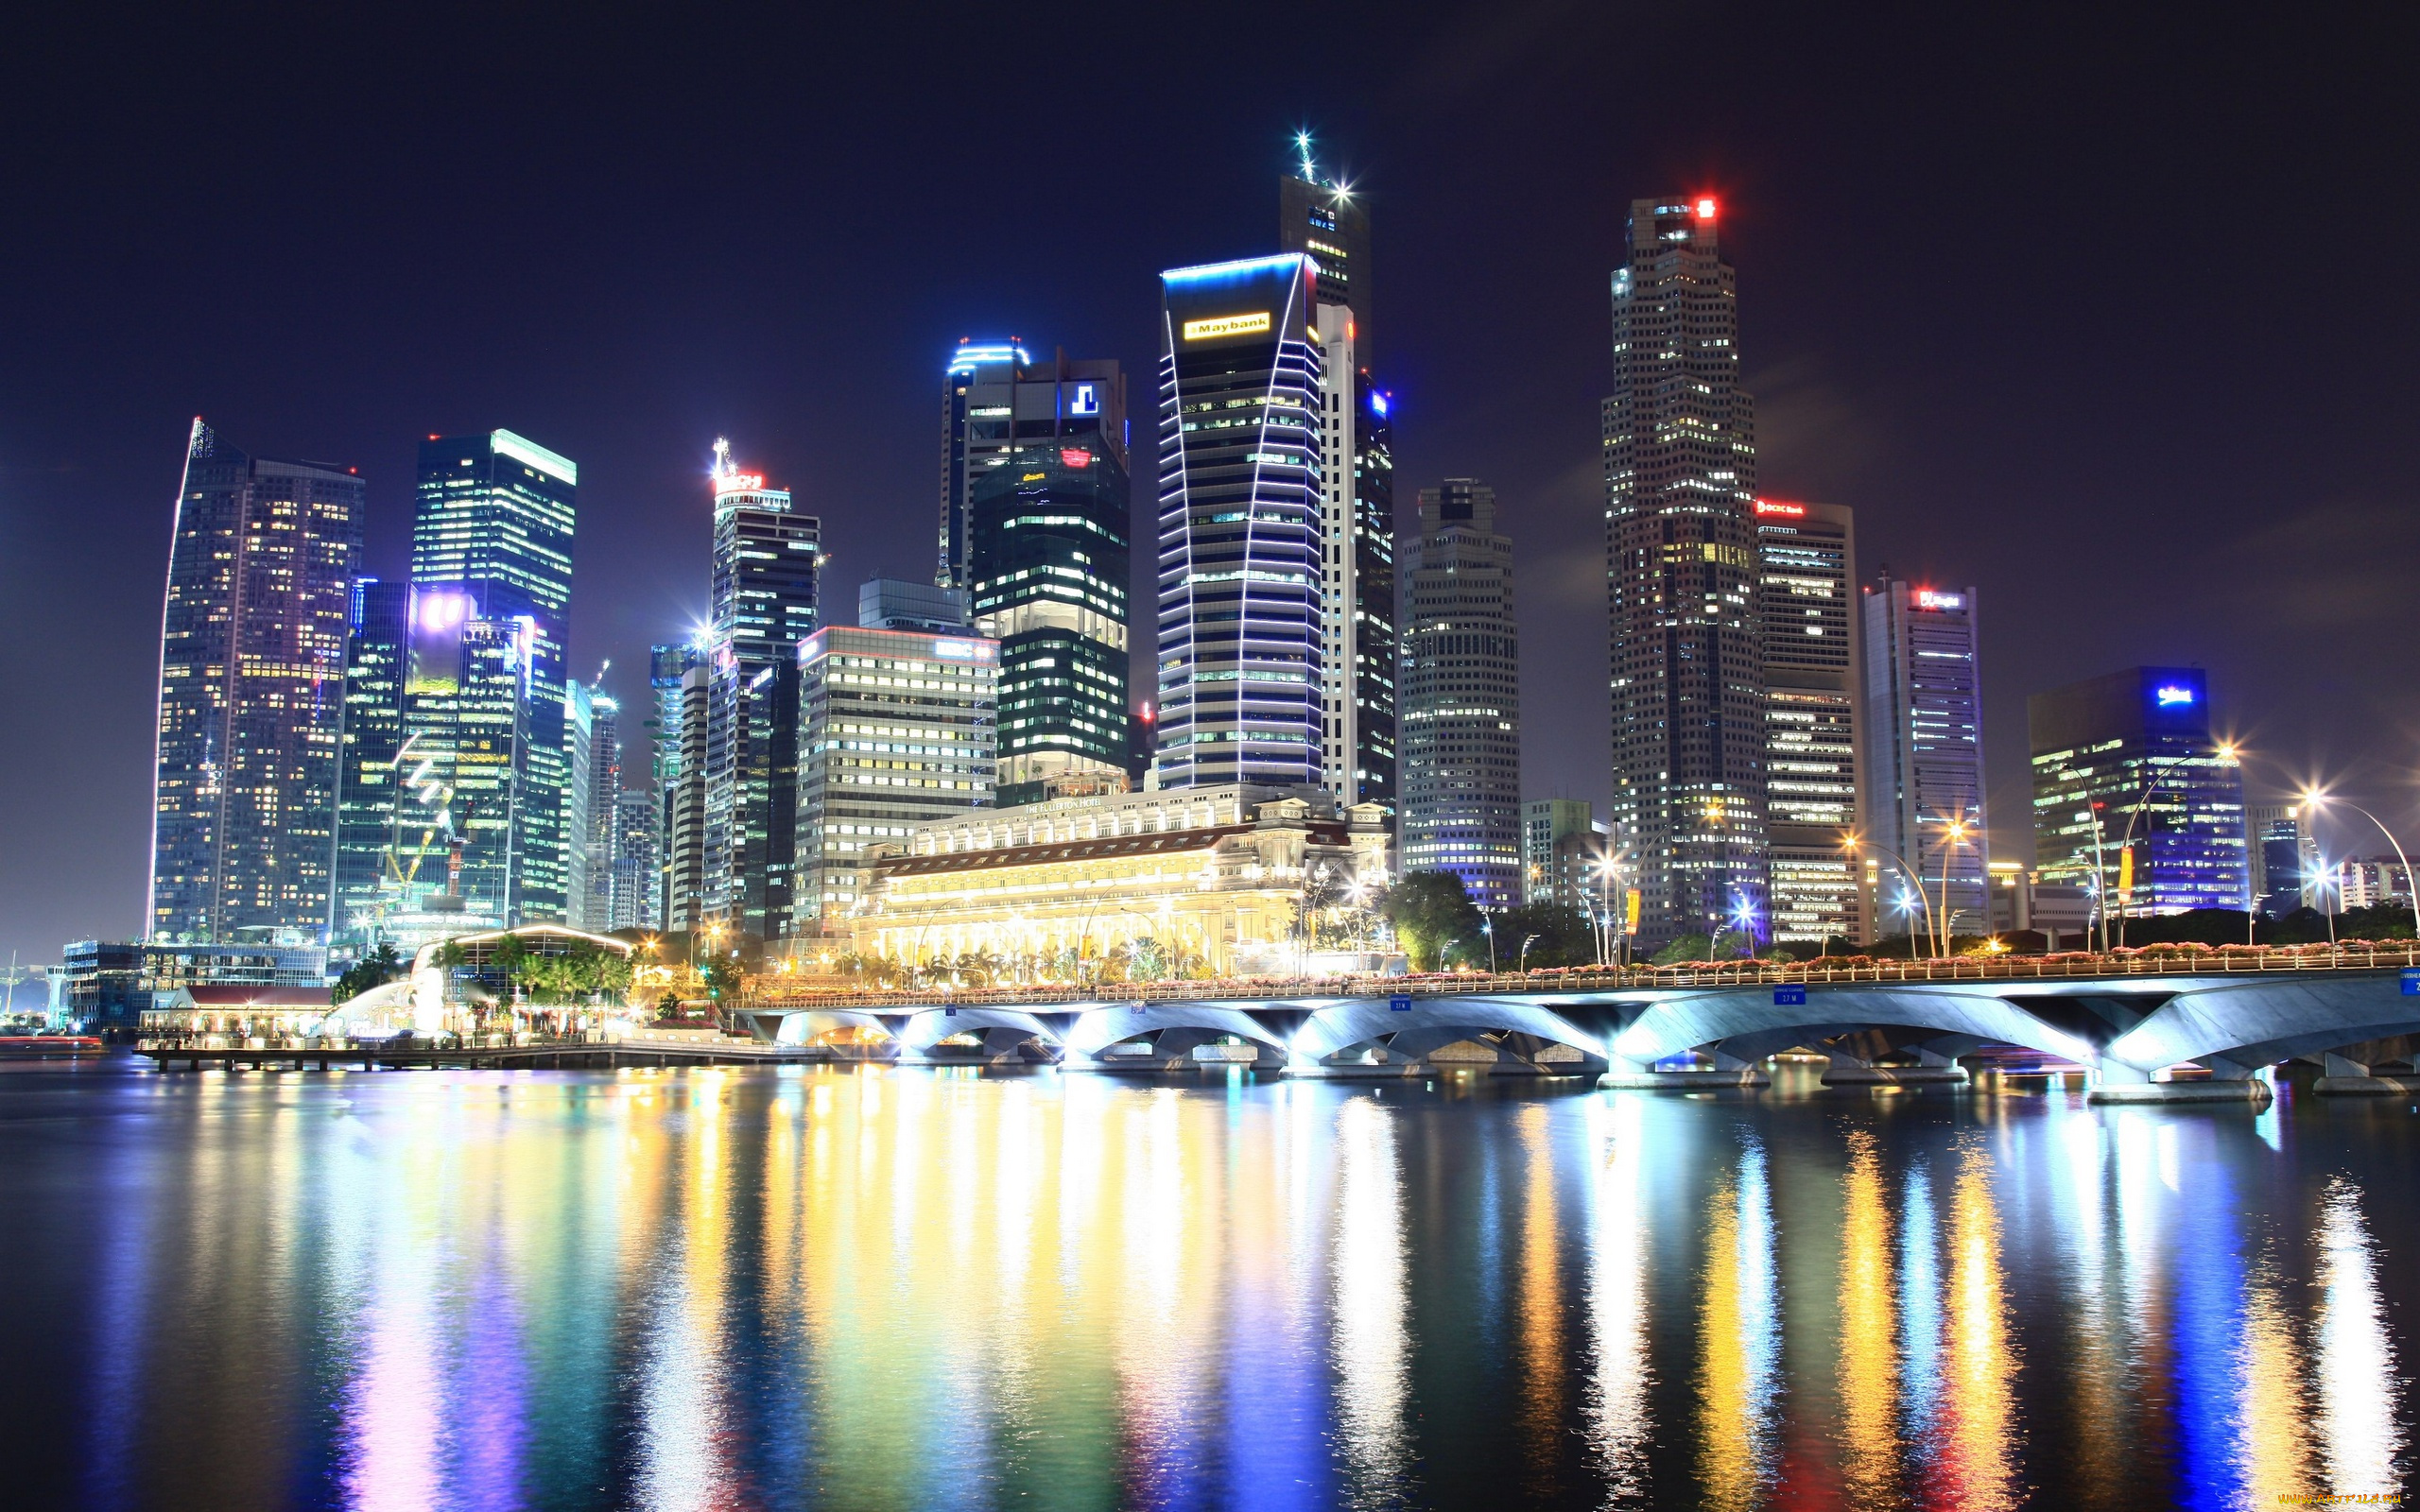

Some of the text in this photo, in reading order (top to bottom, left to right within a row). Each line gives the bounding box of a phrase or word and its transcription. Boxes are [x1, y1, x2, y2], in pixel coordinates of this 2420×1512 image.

[1199, 318, 1267, 333] Maybank
[1026, 797, 1101, 814] THE FULLERTON HOTEL
